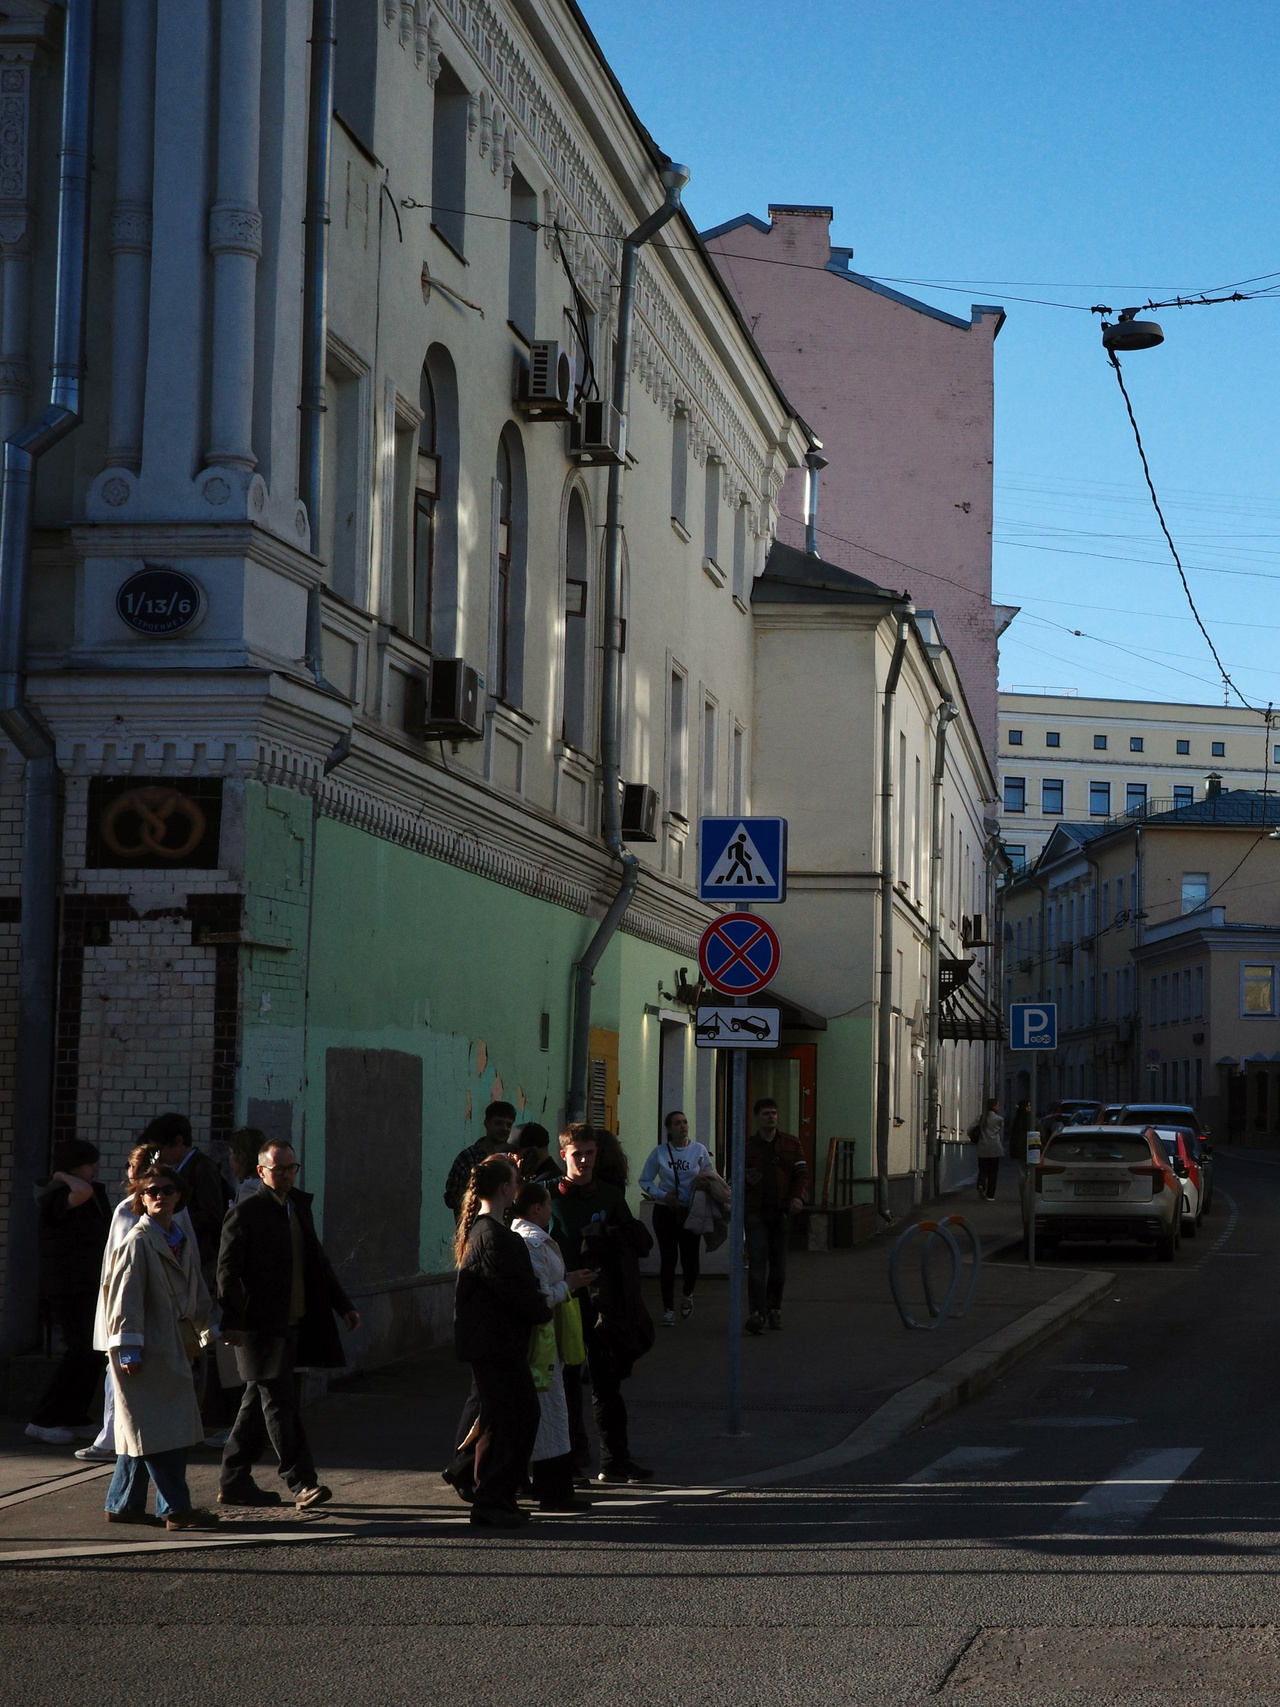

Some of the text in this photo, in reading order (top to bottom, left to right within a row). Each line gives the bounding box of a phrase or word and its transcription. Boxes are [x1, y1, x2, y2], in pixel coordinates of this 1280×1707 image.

[125, 591, 191, 616] 1/13/6
[132, 616, 179, 631] СТРОЕНИЕ
[1023, 1008, 1048, 1044] P
